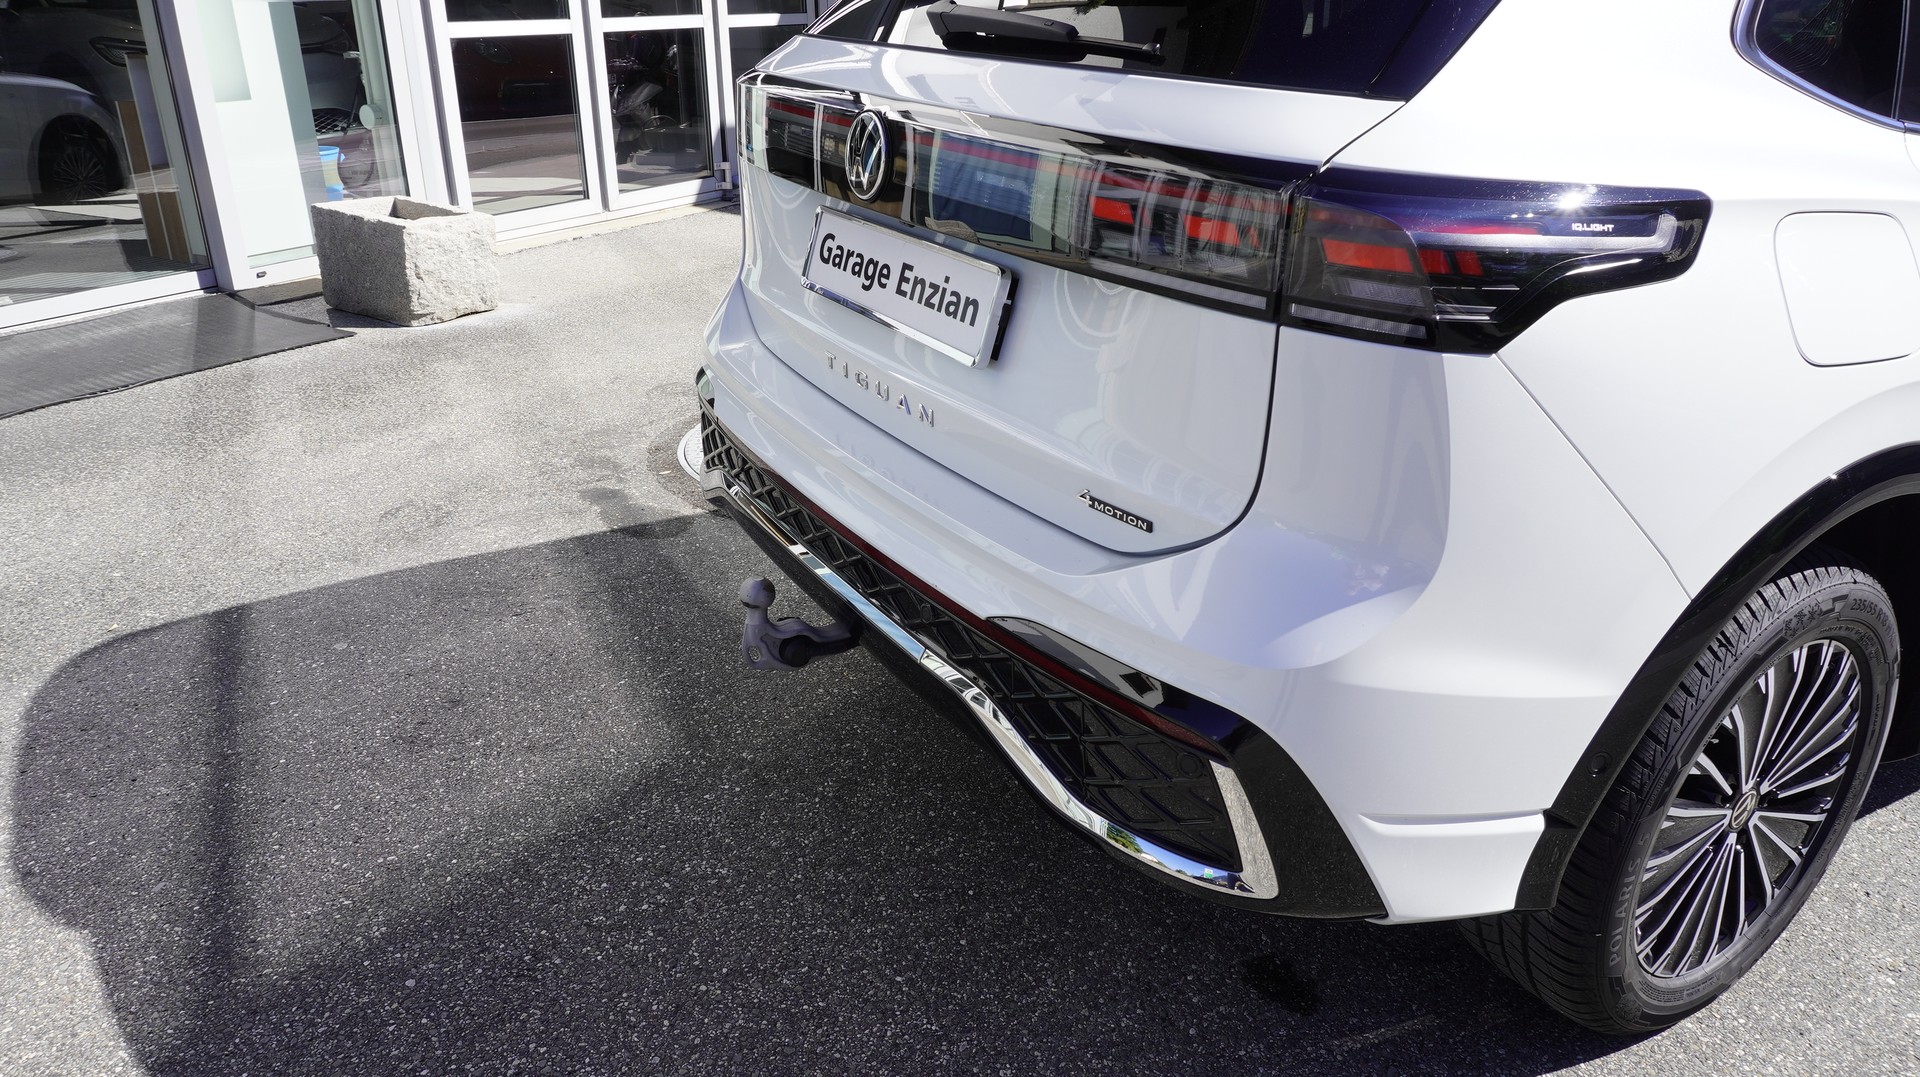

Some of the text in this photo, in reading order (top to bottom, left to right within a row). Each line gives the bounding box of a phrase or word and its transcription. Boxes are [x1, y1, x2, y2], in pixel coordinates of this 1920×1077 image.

[1571, 223, 1615, 232] IQ.LIGHT
[819, 232, 980, 327] Garage Enzian
[824, 351, 934, 427] TIGUAN
[1608, 857, 1642, 966] POLARIS
